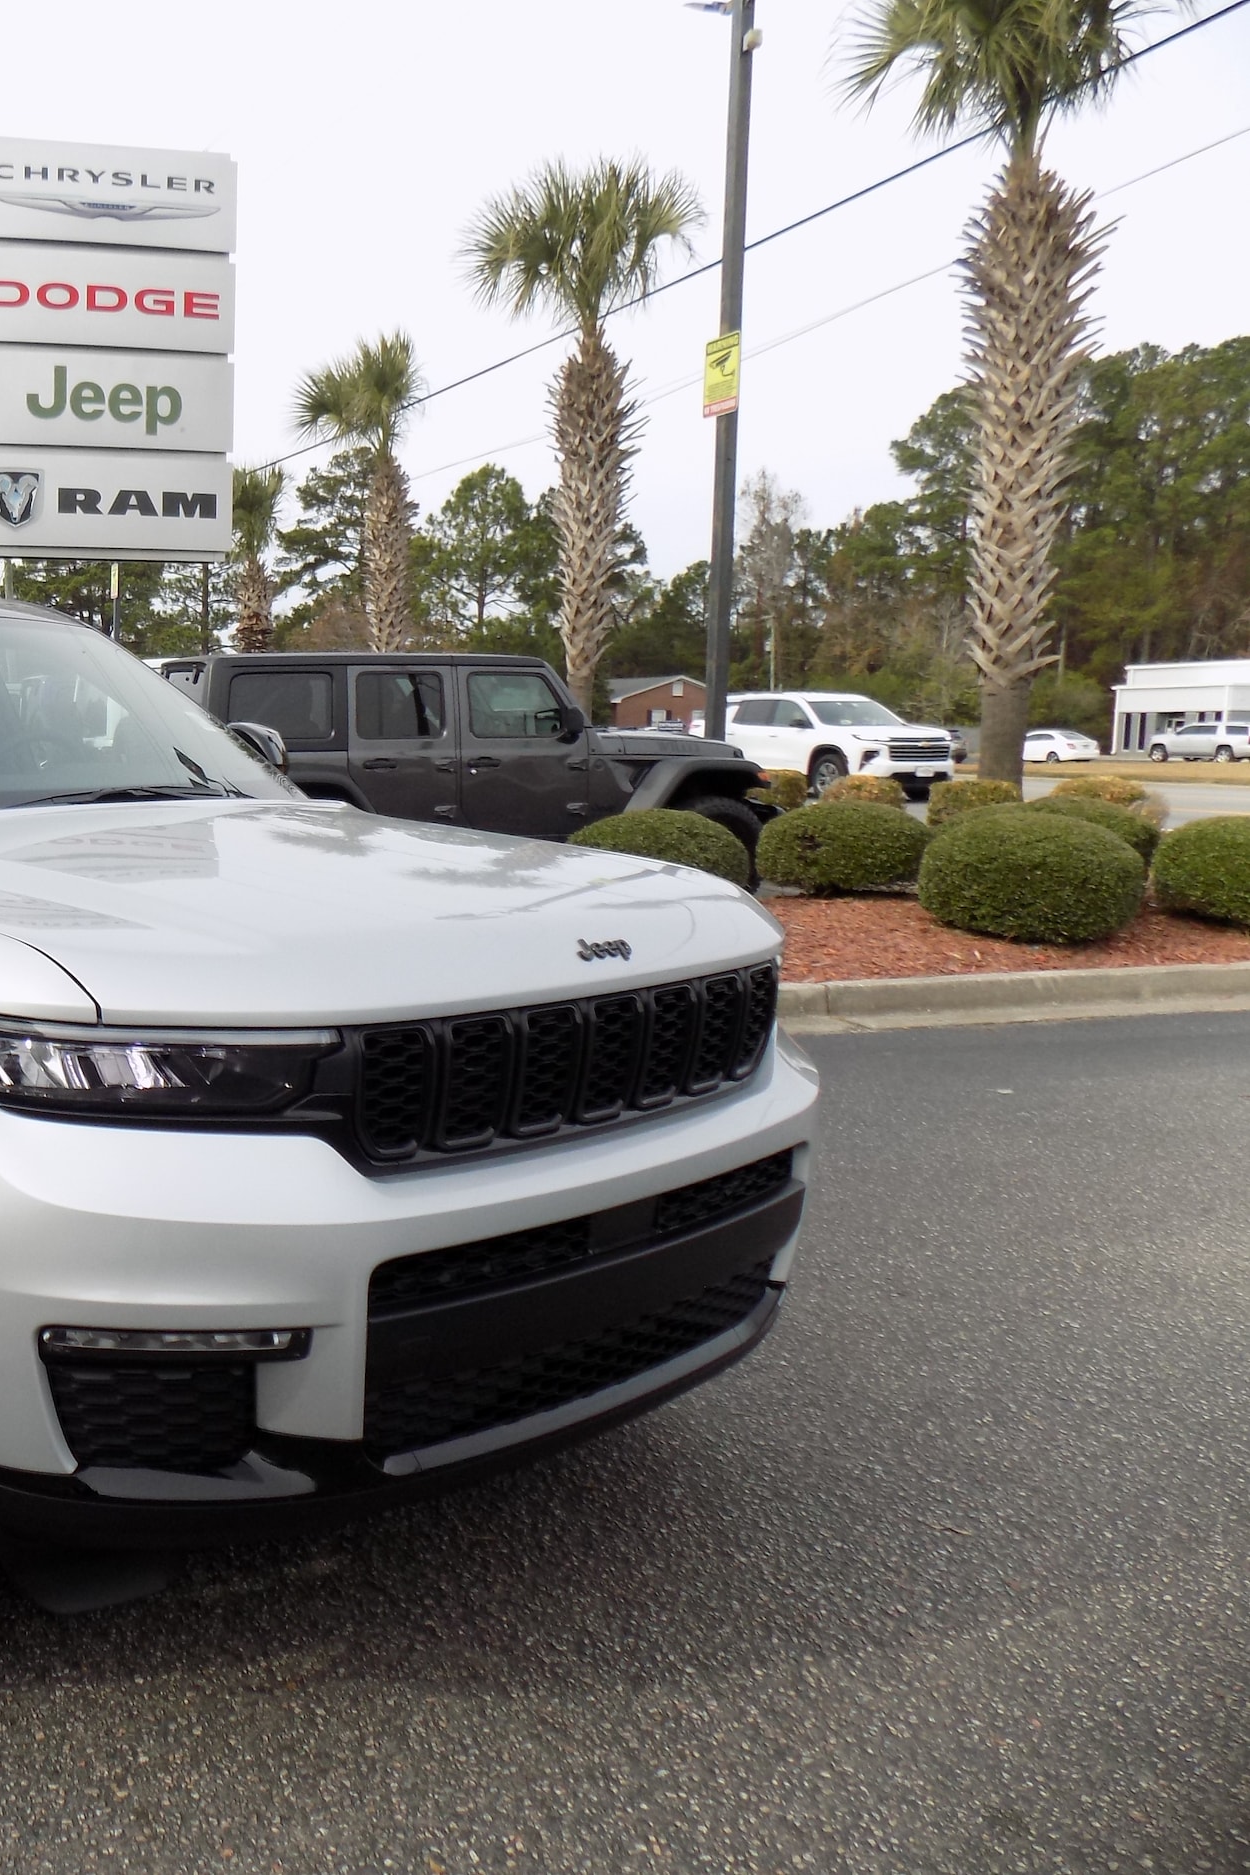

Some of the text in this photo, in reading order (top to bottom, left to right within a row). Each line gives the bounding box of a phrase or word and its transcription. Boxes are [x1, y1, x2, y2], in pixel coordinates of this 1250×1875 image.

[26, 365, 183, 436] Jeep
[57, 487, 218, 519] RAM
[576, 938, 632, 962] Jeep
